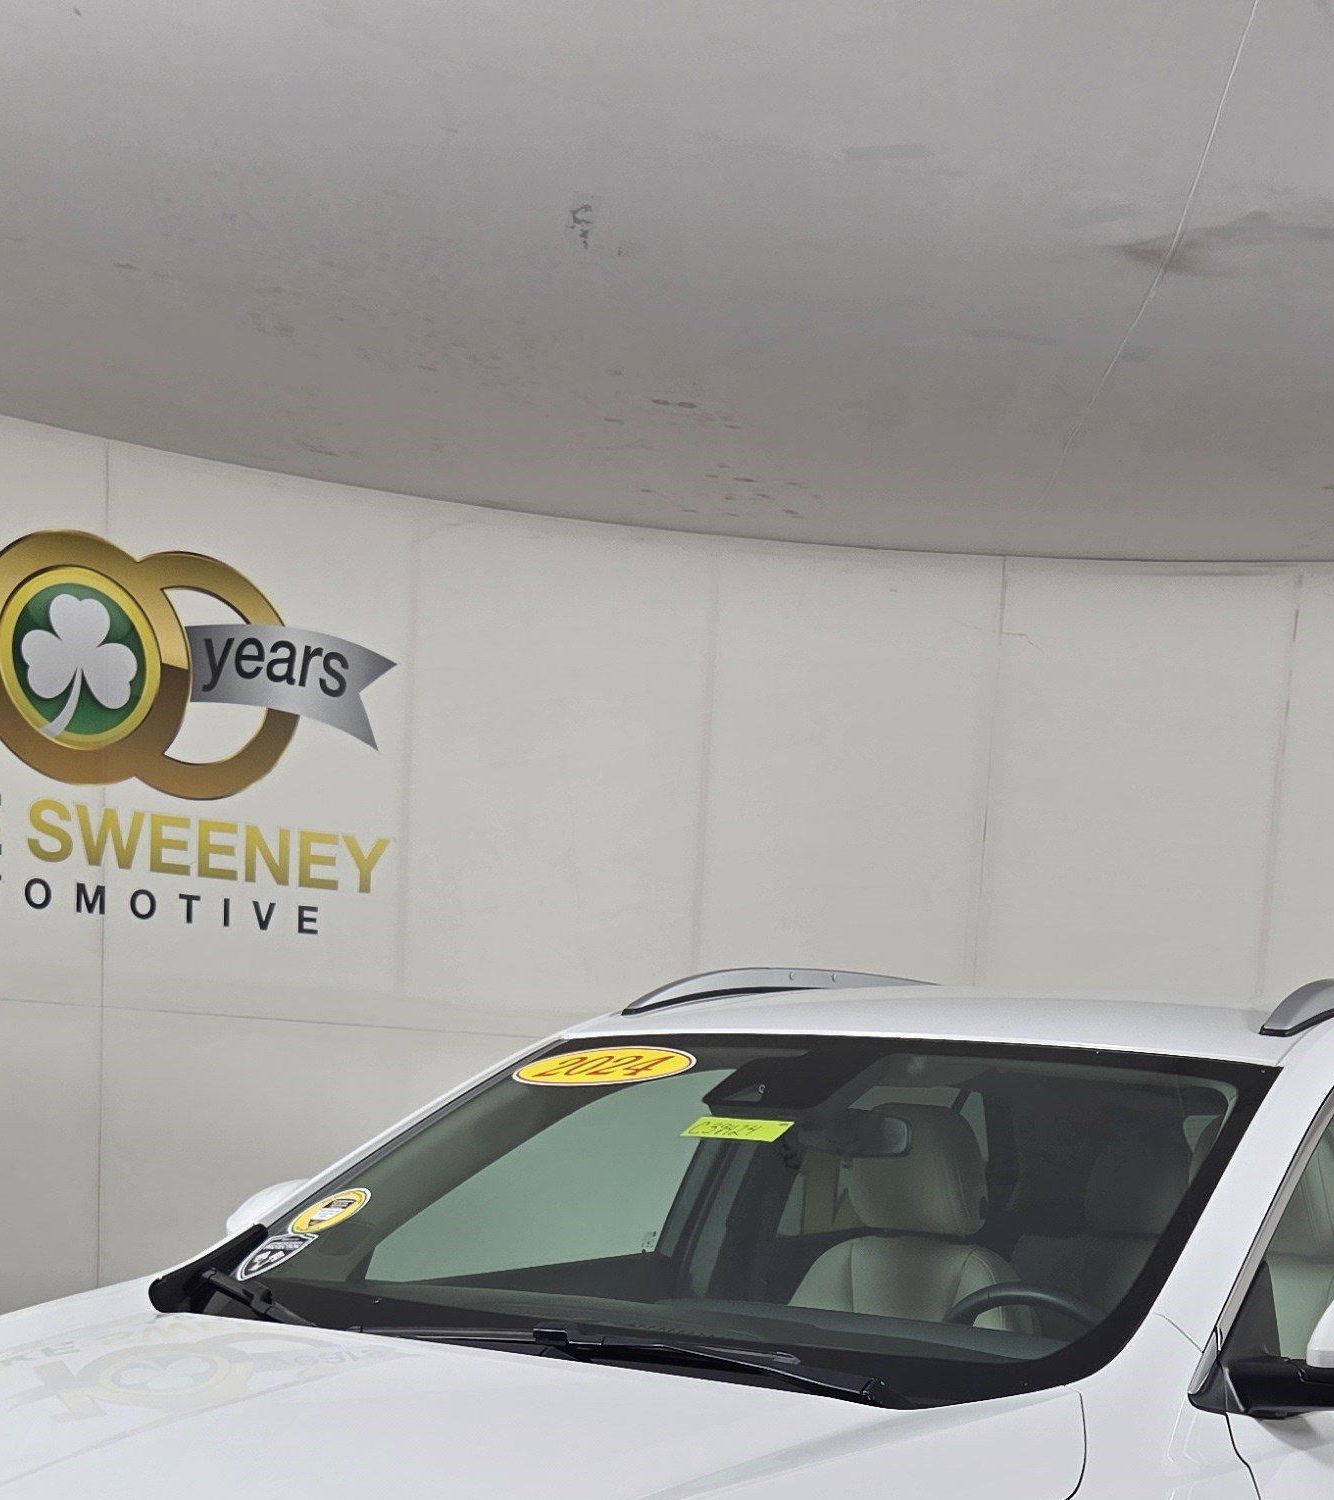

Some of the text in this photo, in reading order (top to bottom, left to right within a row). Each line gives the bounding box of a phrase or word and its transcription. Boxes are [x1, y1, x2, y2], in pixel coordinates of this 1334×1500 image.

[203, 634, 350, 699] years
[27, 798, 390, 894] SWEENEY
[533, 1055, 675, 1077] 2024
